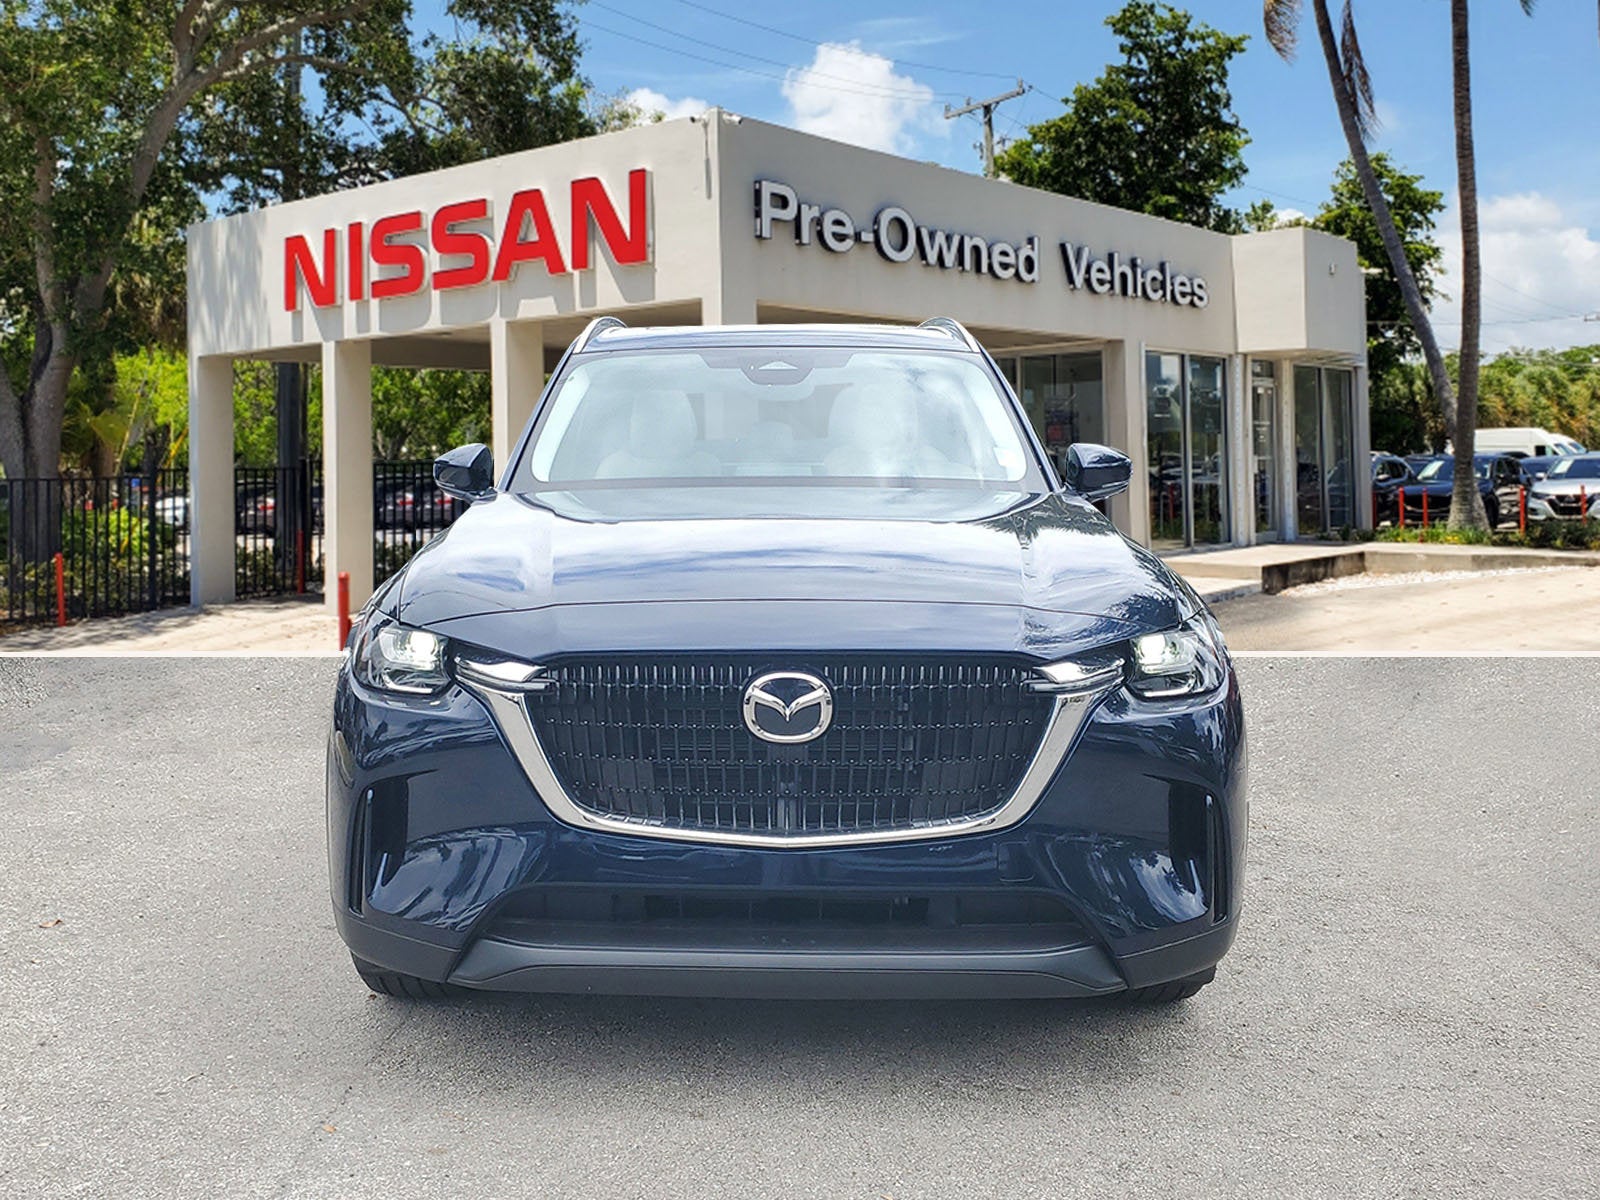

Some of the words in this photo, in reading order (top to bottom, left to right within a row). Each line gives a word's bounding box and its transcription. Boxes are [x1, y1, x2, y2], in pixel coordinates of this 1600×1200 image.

[284, 168, 649, 312] NISSAN
[754, 179, 1040, 283] Pre-Owned
[1061, 241, 1209, 308] Vehicles
